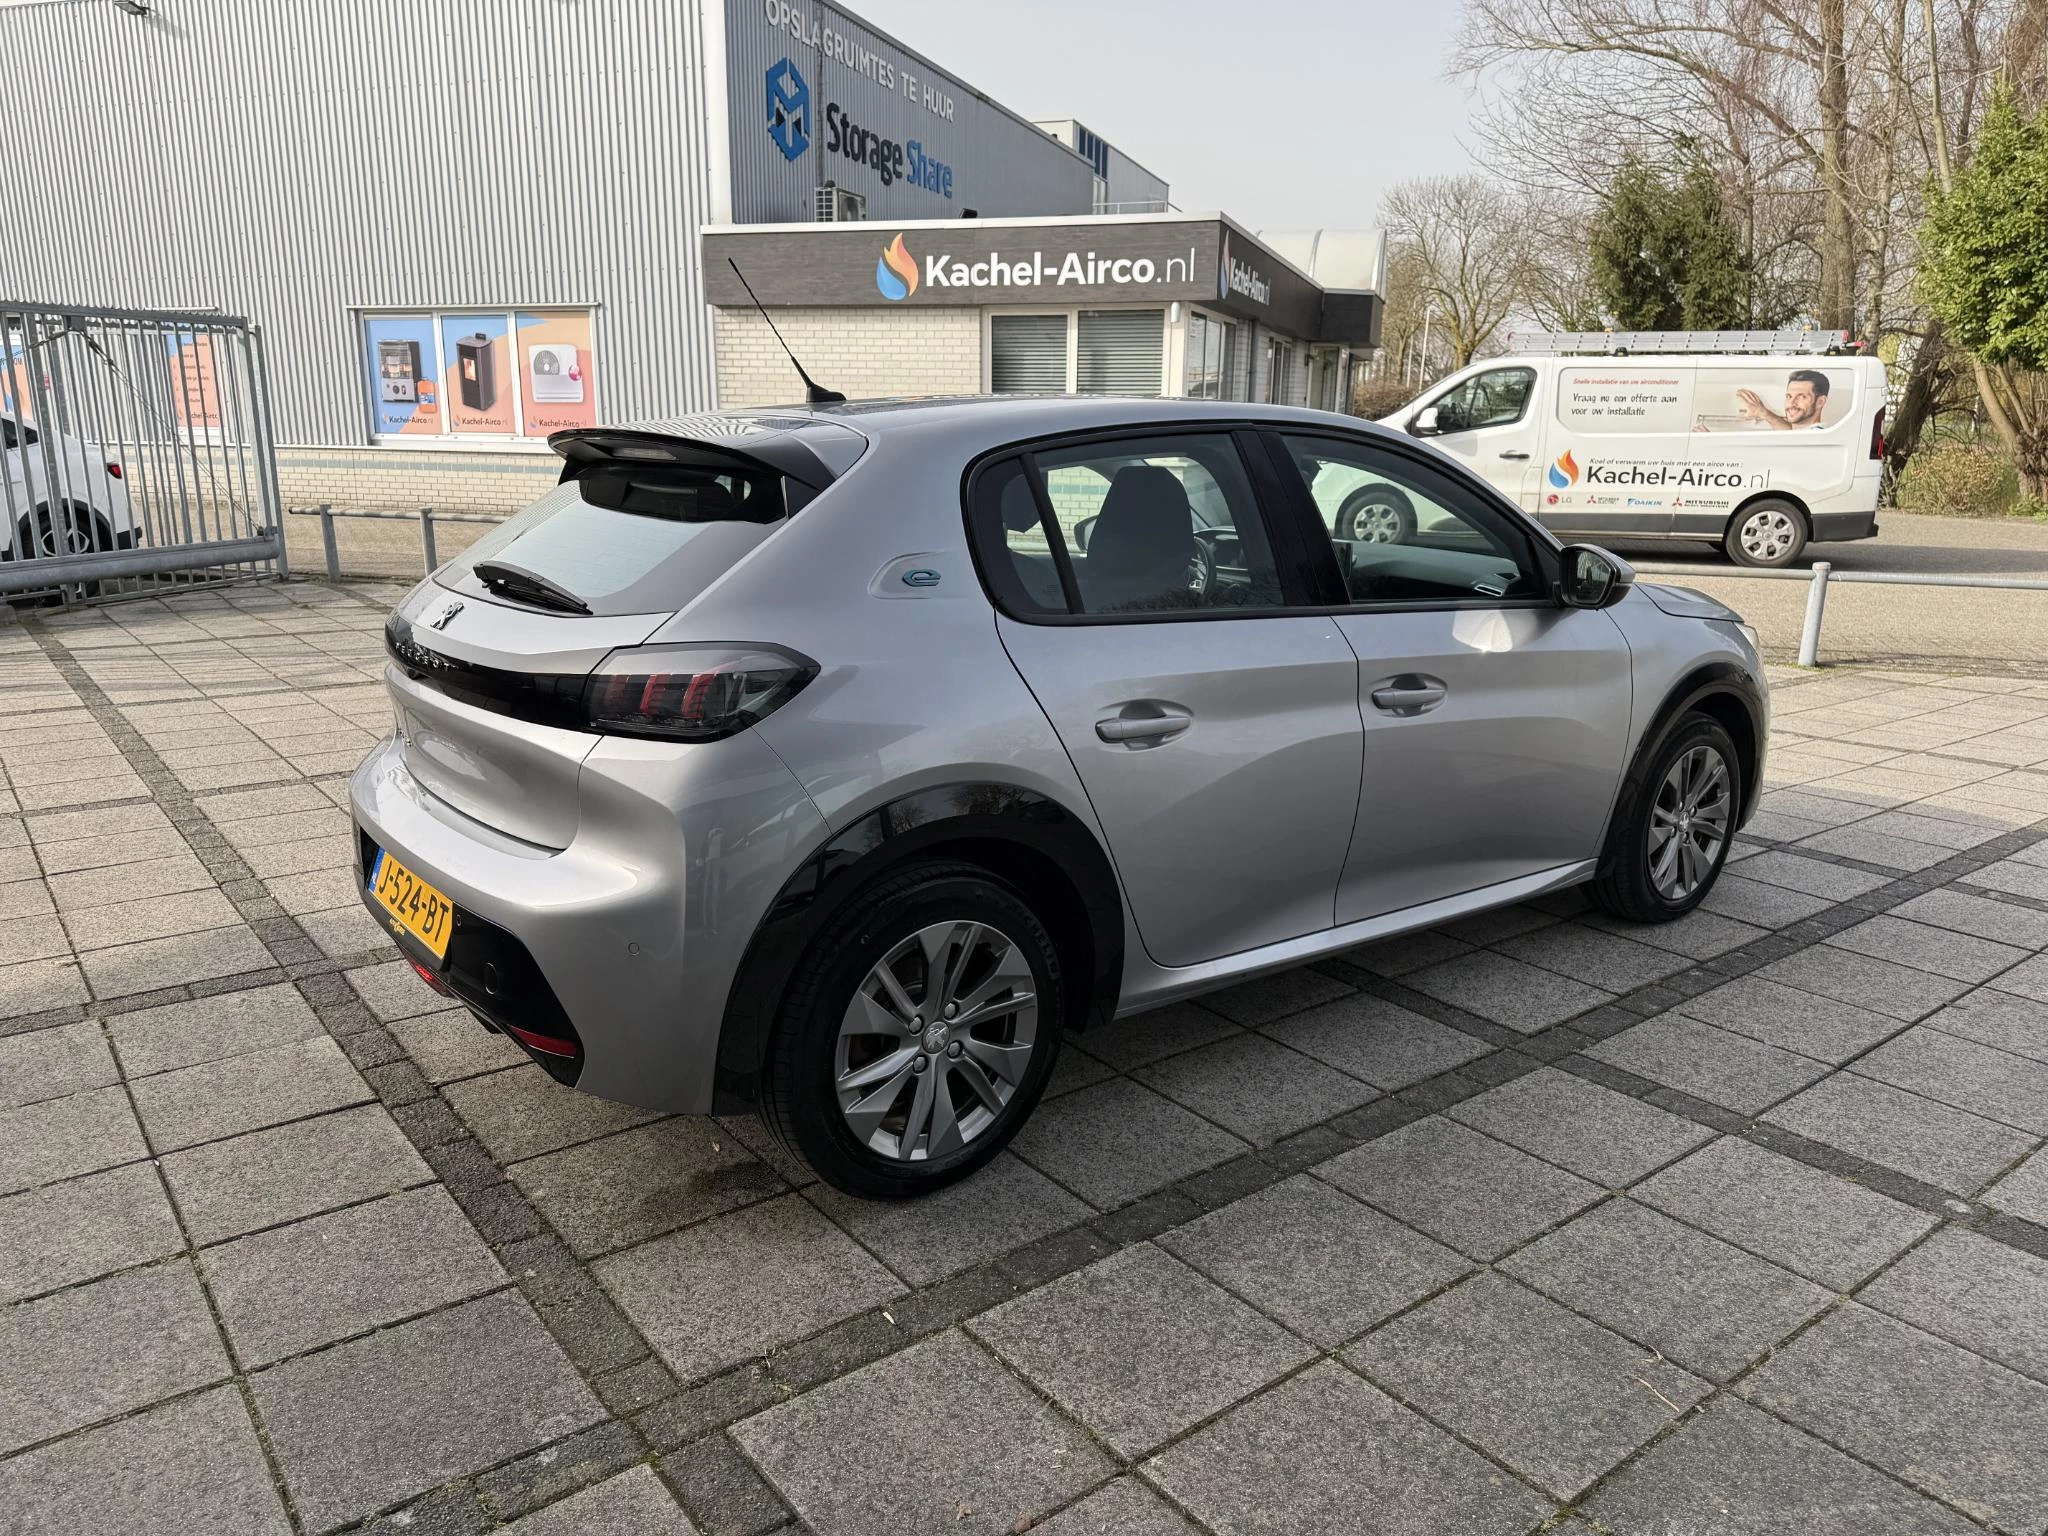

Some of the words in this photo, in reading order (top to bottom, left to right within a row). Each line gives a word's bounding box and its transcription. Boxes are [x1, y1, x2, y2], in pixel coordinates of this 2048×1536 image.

[765, 0, 895, 89] OPSLAGRUIMTES
[901, 72, 917, 103] TE
[923, 84, 954, 123] HUUR
[826, 102, 903, 186] Storage
[906, 139, 953, 199] Share
[925, 248, 1195, 287] Kachel-Airco.nl
[1573, 393, 1596, 403] Vraag
[1630, 393, 1657, 402] offerte
[1607, 406, 1646, 415] installatie
[1587, 465, 1770, 488] Kachel-Airco.nl
[1634, 498, 1663, 506] DAIKIN
[379, 860, 450, 942] J-524-BT
